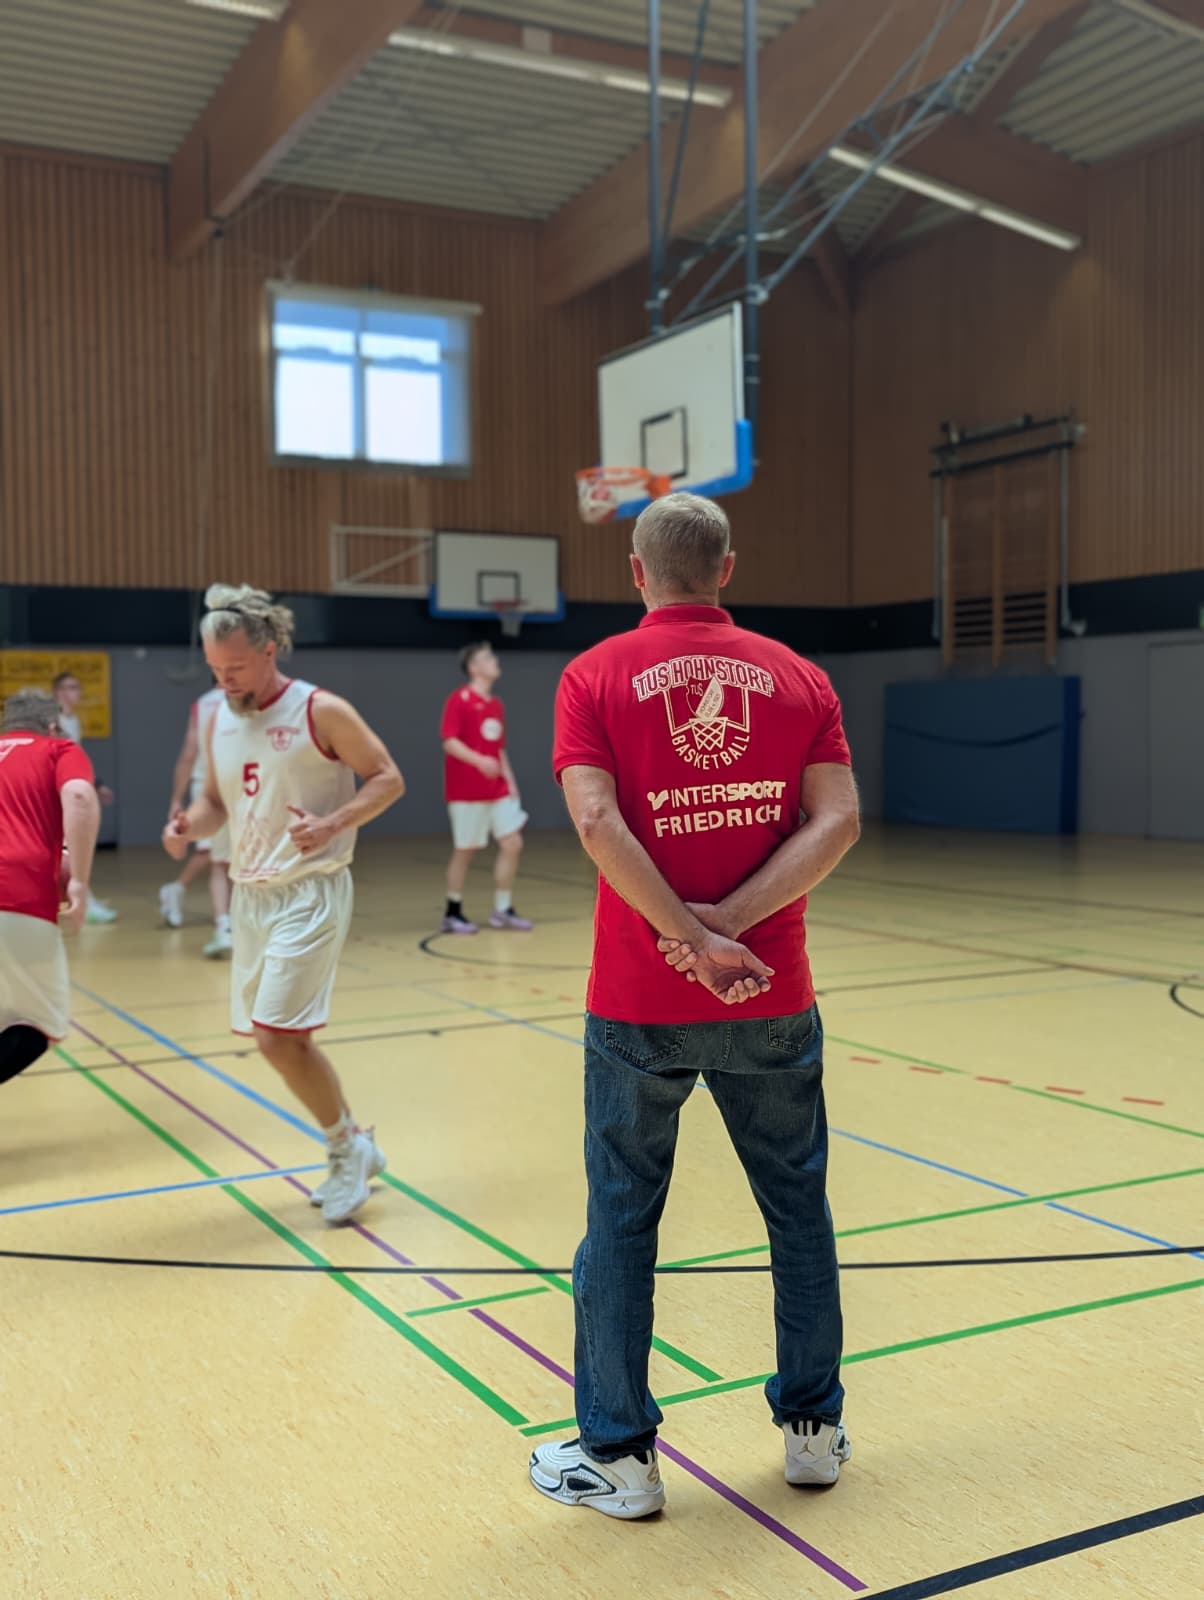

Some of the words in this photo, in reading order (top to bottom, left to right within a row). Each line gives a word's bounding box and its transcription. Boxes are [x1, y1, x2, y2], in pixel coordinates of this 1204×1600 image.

[634, 663, 671, 700] TUS
[672, 734, 750, 770] BASKETBALL
[243, 762, 260, 797] 5
[671, 780, 786, 809] INTERSPORT
[654, 804, 782, 838] FRIEDRICH
